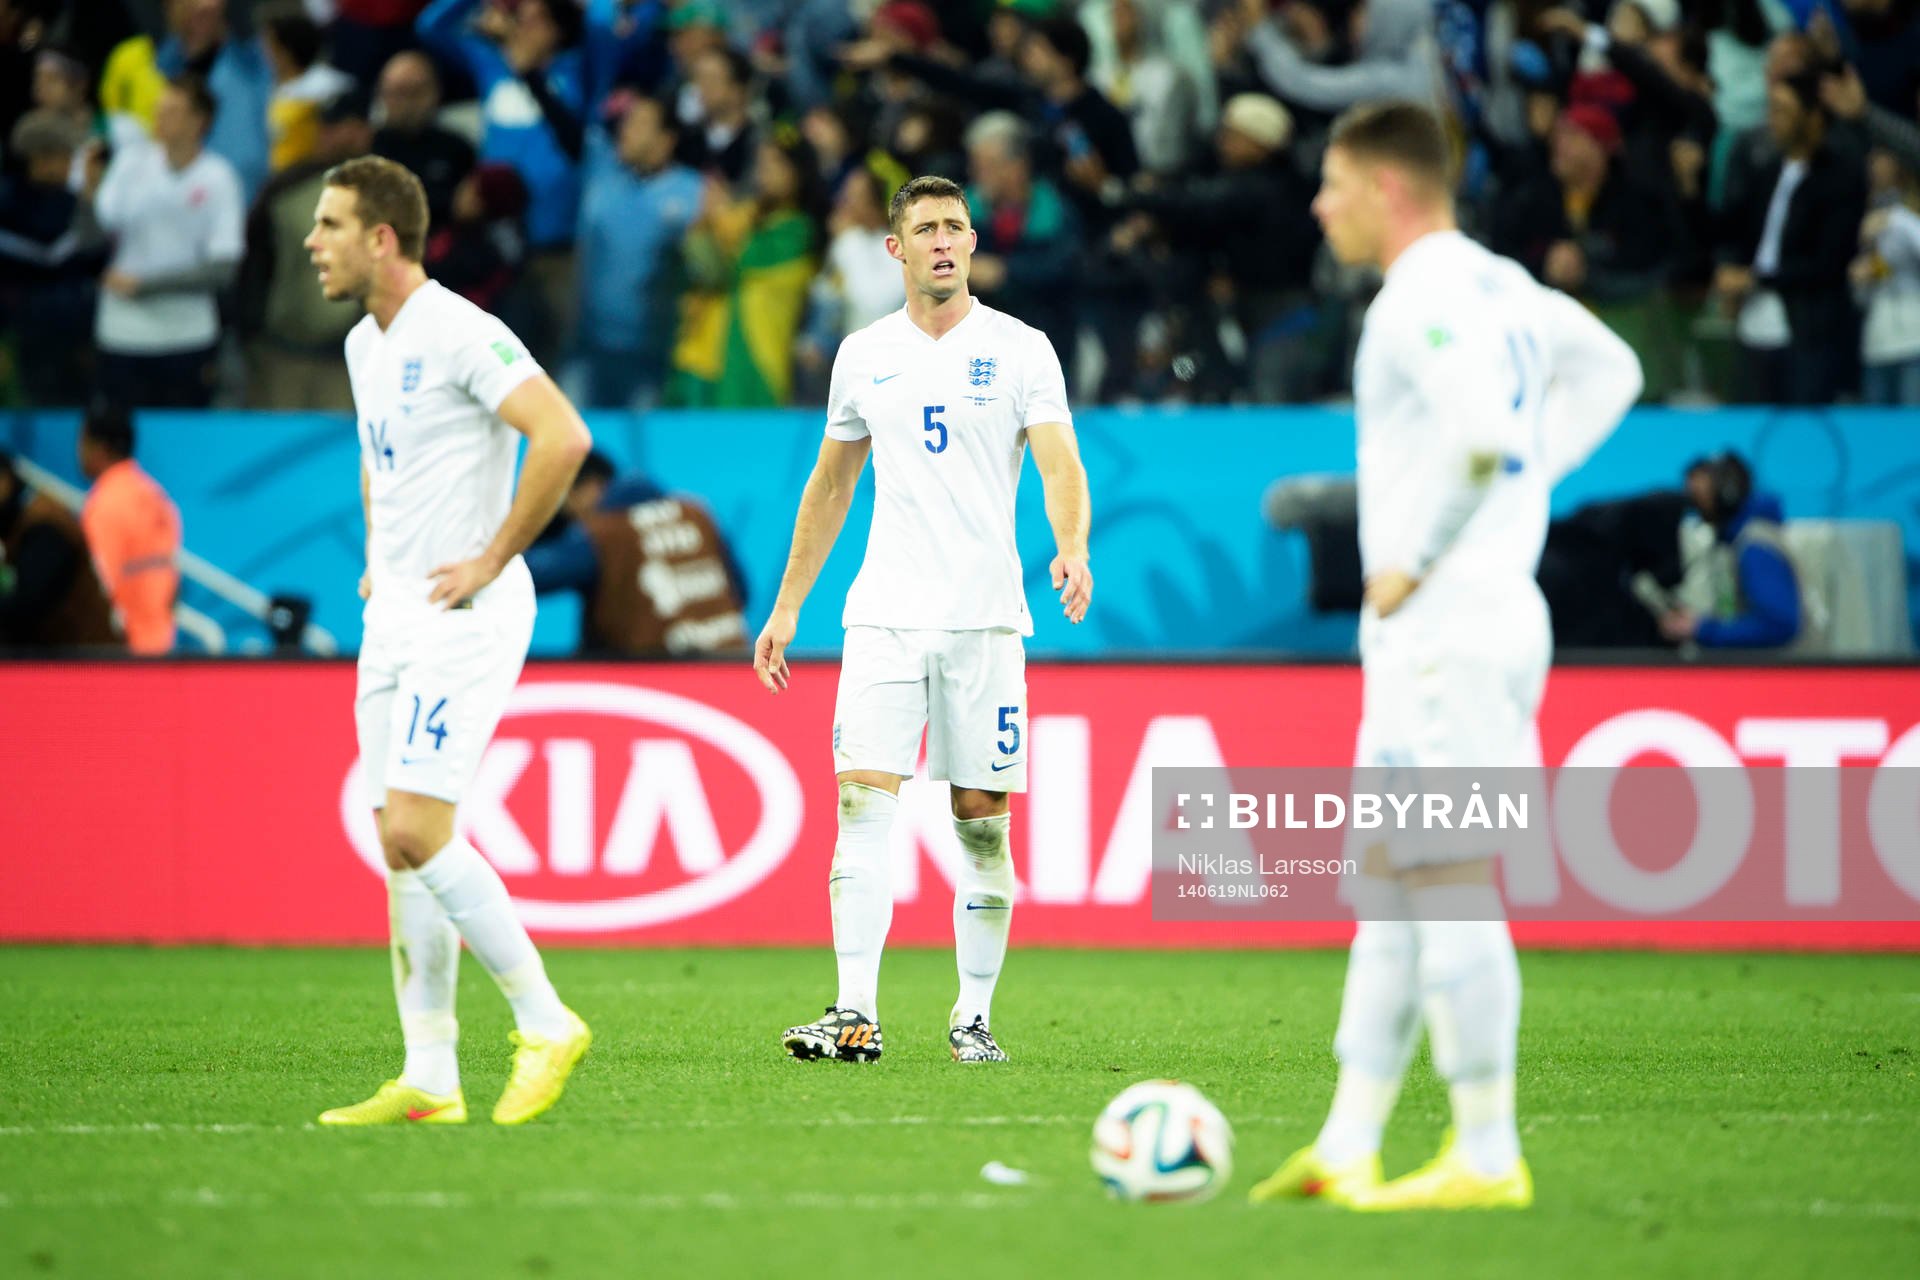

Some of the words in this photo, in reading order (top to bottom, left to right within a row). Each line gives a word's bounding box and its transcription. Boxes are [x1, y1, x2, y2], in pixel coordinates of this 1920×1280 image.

[923, 405, 948, 453] 5
[408, 694, 448, 750] 14
[997, 706, 1020, 755] 5
